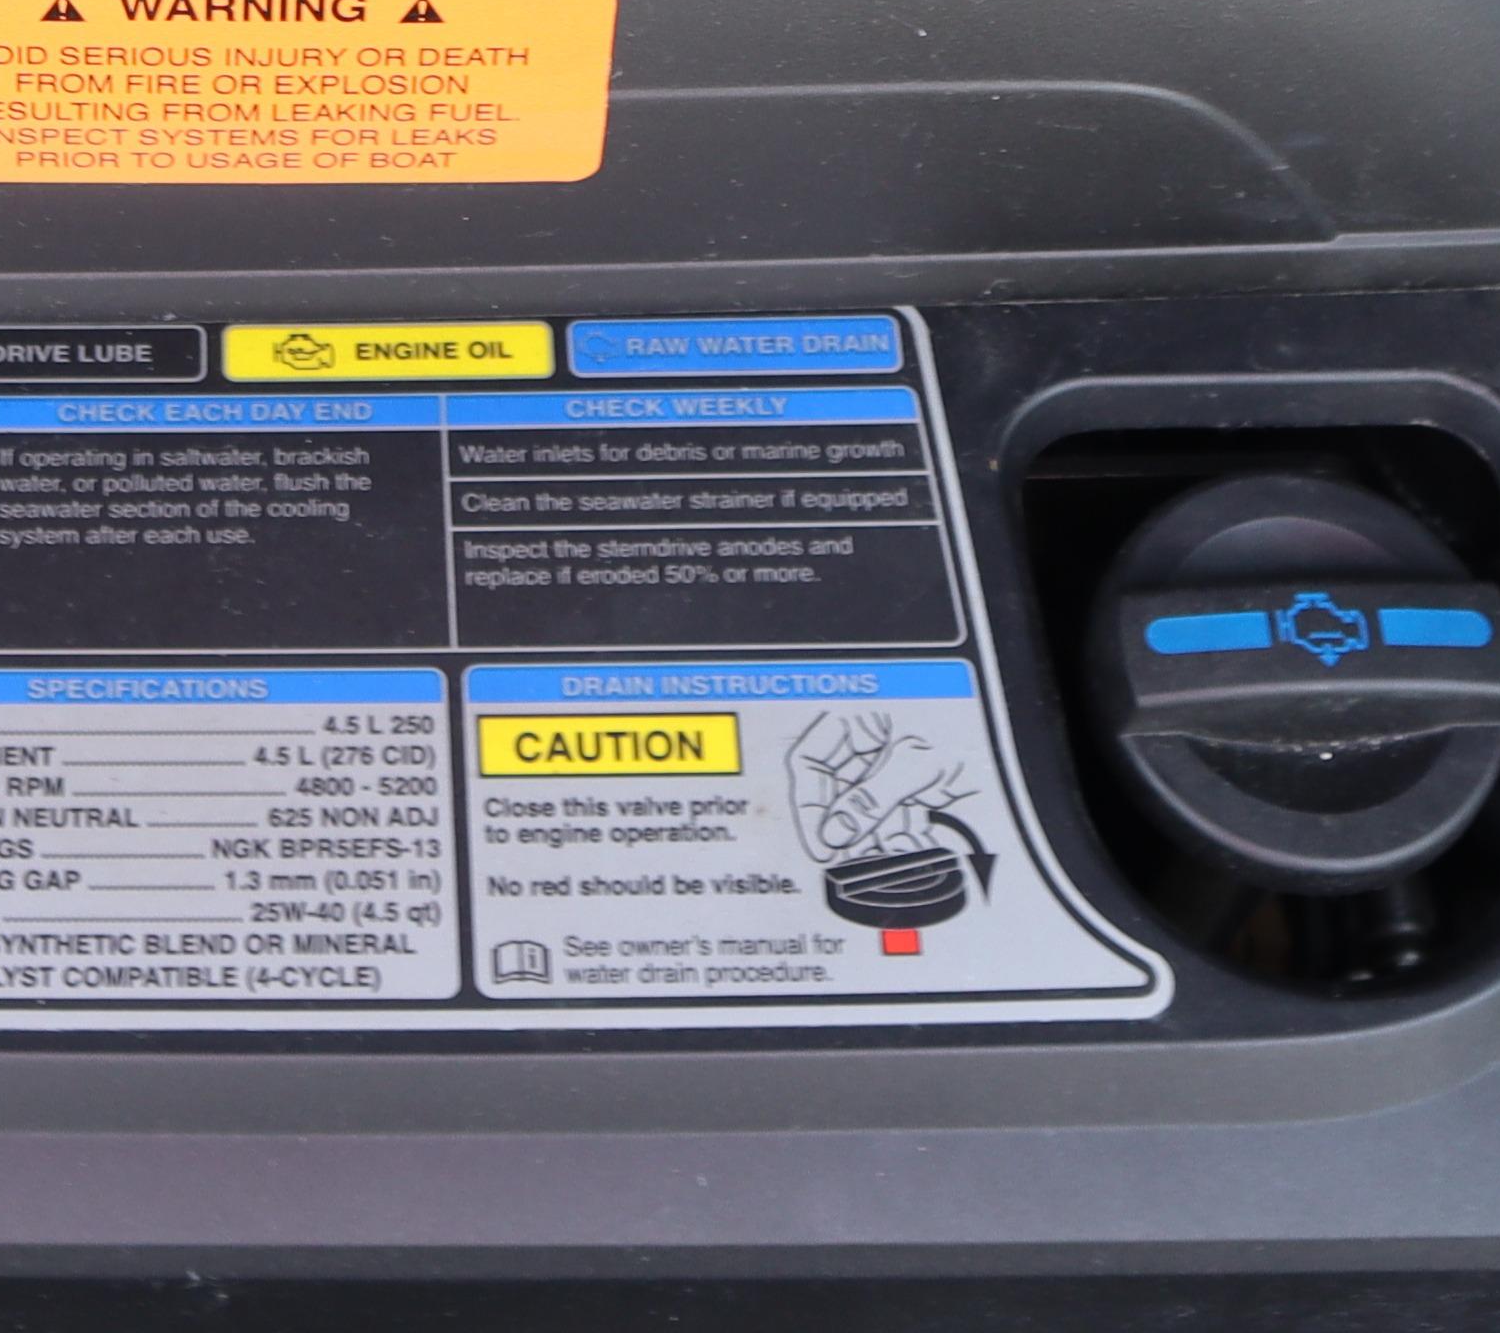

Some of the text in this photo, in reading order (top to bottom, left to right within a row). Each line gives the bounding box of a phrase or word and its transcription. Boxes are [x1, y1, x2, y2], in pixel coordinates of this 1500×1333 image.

[60, 45, 211, 67] SERIOUS
[224, 46, 344, 67] INJURY
[356, 47, 407, 67] OR
[418, 47, 528, 67] DEATH
[14, 73, 469, 95] FROM FIRE OR EXPLOSION
[162, 102, 260, 123] FROM
[272, 102, 416, 123] LEAKING
[428, 103, 519, 122] FUEL.
[139, 127, 299, 147] SYSTEMS
[310, 127, 379, 146] FOR
[383, 127, 497, 146] LEAKS
[15, 151, 458, 170] PRIOR TO USAGE OF BOAT
[77, 344, 153, 363] LUBE
[355, 339, 513, 360] ENGINE OIL
[626, 333, 890, 356] RAW WATER DRAIN
[57, 403, 373, 423] CHECK EACH DAY END
[564, 397, 787, 418] CHECK WEEKLY
[461, 488, 907, 513] Clean the seawater strainer if equipped
[27, 678, 269, 699] SPECIFICATIONS
[562, 674, 879, 696] DRAIN INSTRUCTIONS
[323, 715, 435, 734] 4.5 L 250
[253, 746, 437, 770] 4.5 L (276 CID)
[514, 731, 705, 764] CAUTION
[6, 776, 65, 797] RPM
[295, 777, 354, 796] 4800
[378, 777, 438, 796] 5200
[12, 807, 140, 828] NEUTRAL
[268, 807, 439, 827] 625 NON ADJ
[484, 795, 748, 821] Close this valve prior
[485, 823, 736, 849] to engine operation.
[211, 838, 442, 859] NGK BPR5EFS-13
[23, 870, 82, 891] GAP
[225, 870, 442, 895] 1.3 mm (0.051 in)
[487, 873, 802, 897] No red should be visible.
[251, 902, 442, 928] 25W-40 (4.5 qt)
[144, 934, 237, 955] BLEND
[244, 934, 285, 955] OR
[291, 934, 417, 955] MINERAL
[62, 965, 239, 988] COMPATIBLE
[246, 966, 382, 992] (4-CYCLE)
